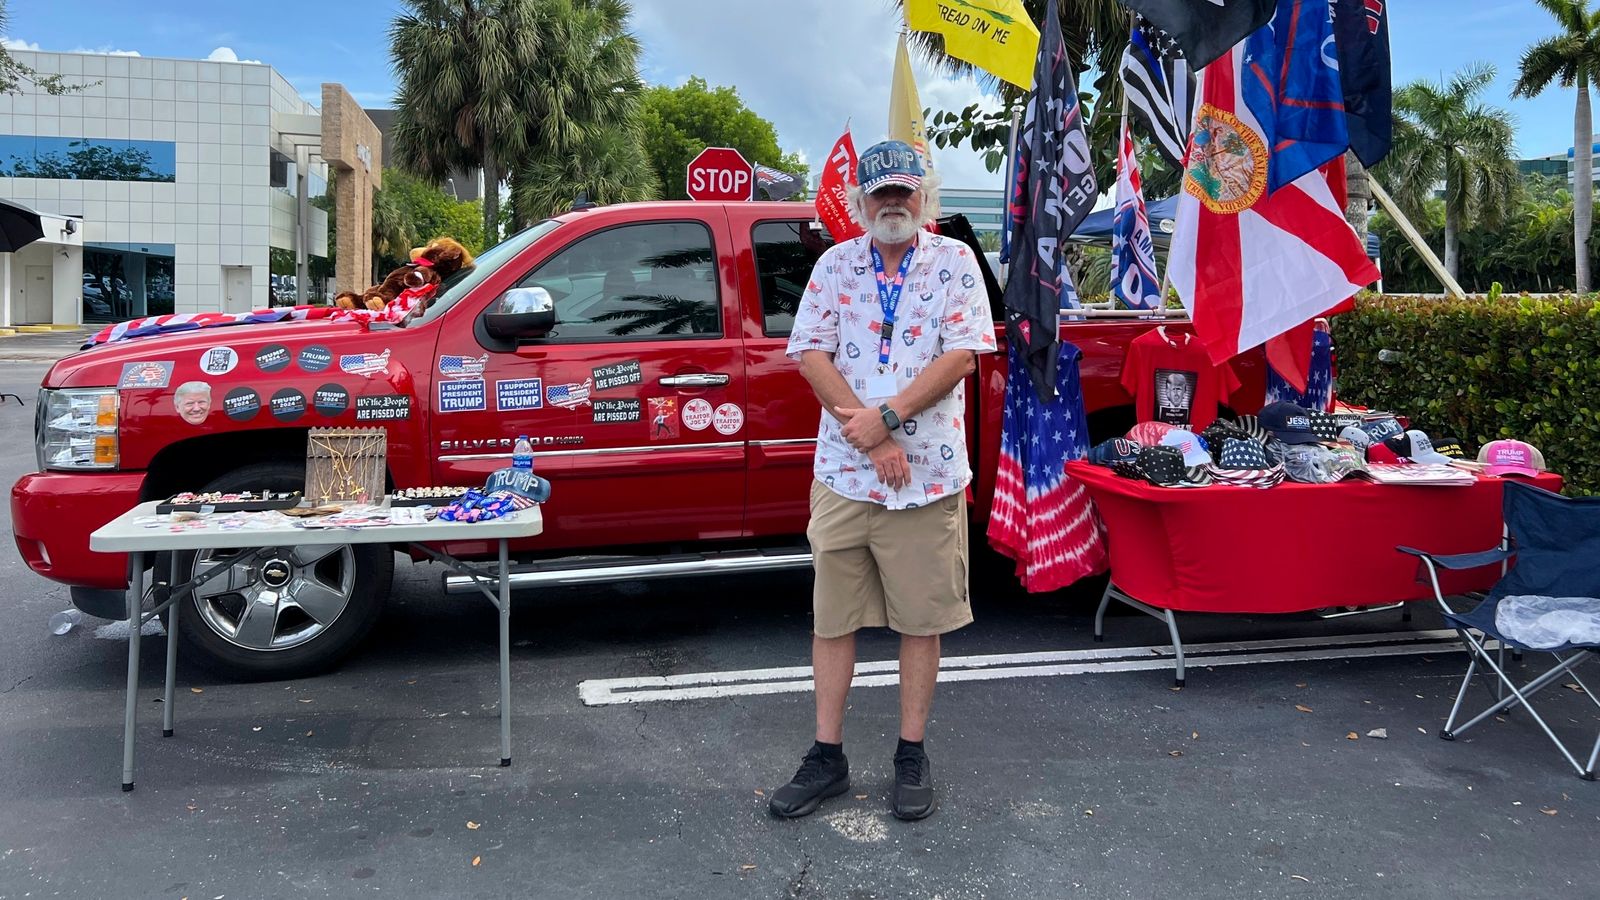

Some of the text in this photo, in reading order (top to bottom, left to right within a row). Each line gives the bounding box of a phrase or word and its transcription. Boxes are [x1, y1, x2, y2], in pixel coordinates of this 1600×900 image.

[938, 4, 1010, 44] TREAD ON ME
[1229, 114, 1242, 128] OF
[1240, 128, 1256, 148] THE
[861, 150, 914, 176] TRUMP
[1255, 148, 1265, 175] STATE
[692, 168, 748, 193] STOP
[1253, 180, 1262, 191] OF
[823, 193, 840, 218] AMERICA
[1219, 191, 1257, 211] FLORIDA
[908, 283, 928, 292] USA
[971, 306, 987, 316] USA
[256, 348, 285, 361] TRUMP
[301, 351, 330, 361] TRUMP
[593, 363, 639, 377] We the People
[906, 367, 925, 378] US
[503, 382, 538, 390] SUPPORT
[596, 373, 641, 389] ARE PISSED OFF
[225, 393, 256, 405] TRUMP
[233, 400, 250, 408] 2024
[272, 395, 302, 405] TRUMP
[357, 396, 408, 407] We the People
[443, 397, 483, 408] TRUMP
[500, 396, 539, 407] TRUMP
[593, 400, 639, 411] We the People
[357, 408, 409, 419] ARE PISSED OFF
[593, 411, 640, 422] ARE PISSED OFF
[685, 413, 711, 421] TRAITOR
[440, 436, 554, 450] SILVERDO
[1115, 438, 1141, 456] US
[906, 454, 929, 465] USA
[493, 470, 539, 492] TRUMP
